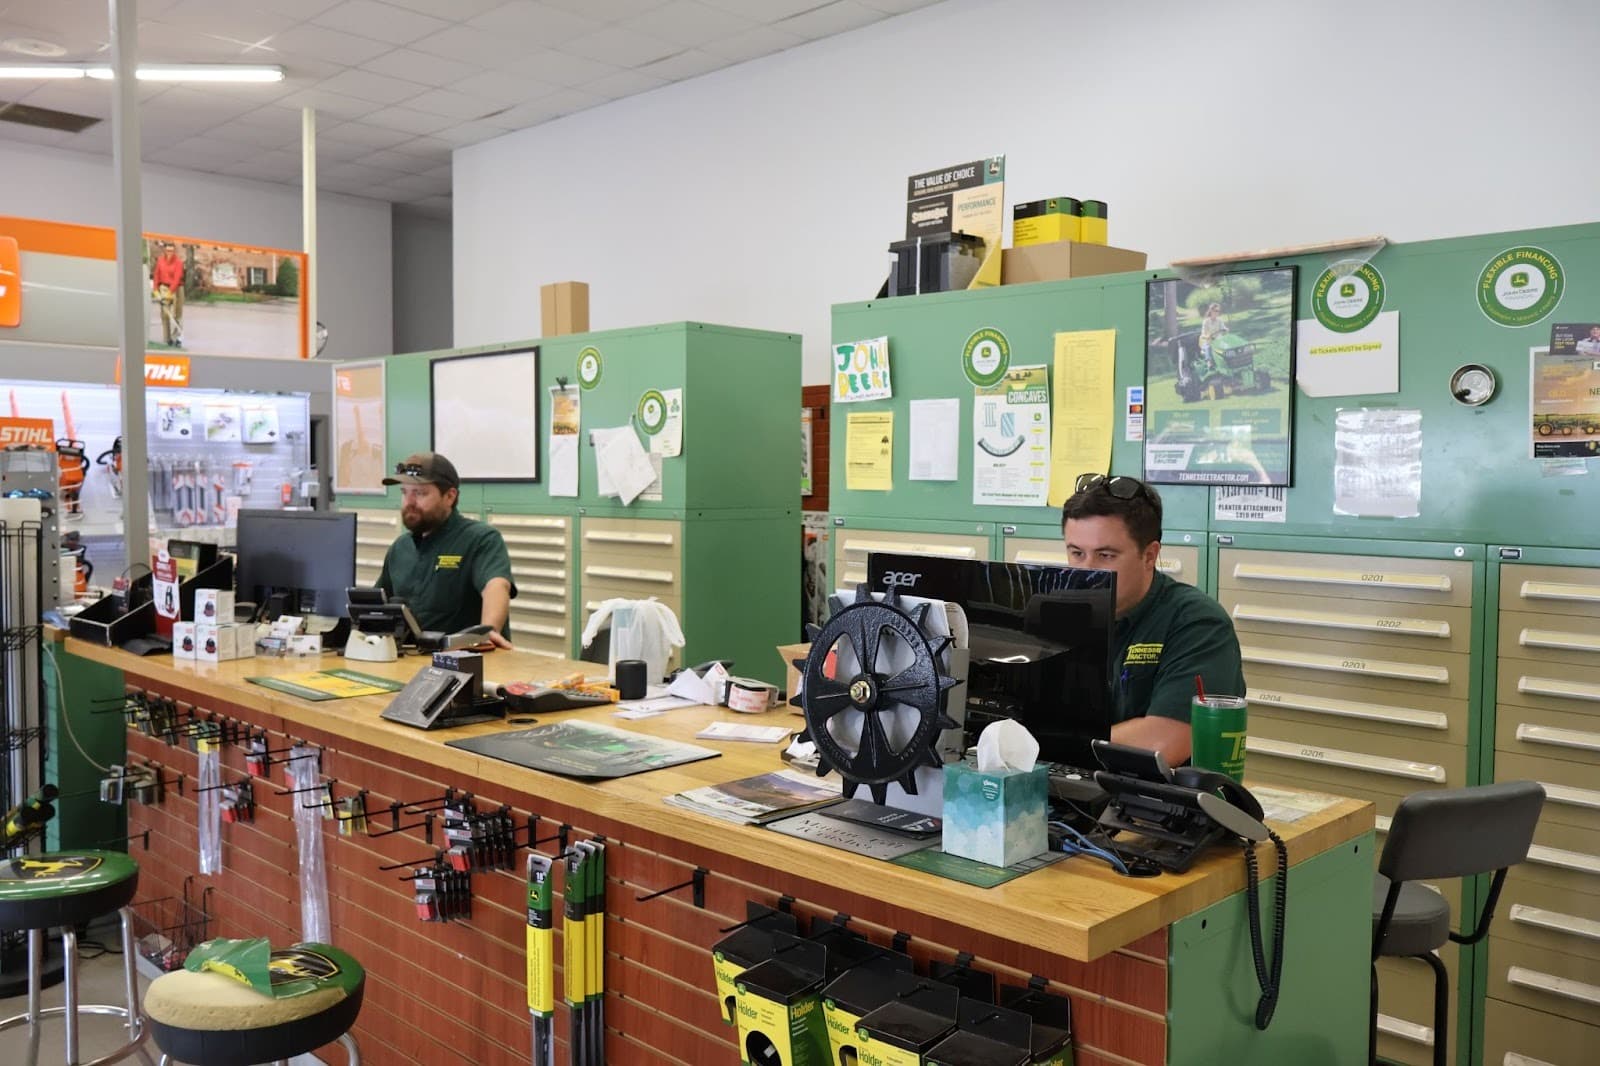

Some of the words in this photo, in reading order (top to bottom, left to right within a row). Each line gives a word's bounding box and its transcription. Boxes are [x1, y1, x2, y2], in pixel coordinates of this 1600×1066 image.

[914, 178, 927, 189] THE
[944, 171, 953, 182] OF
[953, 166, 976, 180] CHOICE
[1483, 254, 1514, 289] FLEXIBLE
[1516, 251, 1558, 280] FINANCING
[1318, 346, 1338, 355] Tickets
[1338, 345, 1354, 353] MUST
[1362, 342, 1382, 352] Signed
[836, 343, 887, 372] JOHN
[145, 363, 187, 380] TIHL
[838, 370, 888, 398] DEERE
[1007, 390, 1047, 404] CONCAVES
[0, 426, 52, 444] STIHL
[1242, 504, 1282, 513] ATTACHMENTS
[882, 570, 922, 587] acer
[1361, 573, 1384, 583] 0201
[1376, 619, 1402, 629] 0202
[1341, 660, 1366, 670] 0203
[1259, 693, 1281, 702] 0204
[738, 1002, 759, 1020] Holder
[791, 1000, 815, 1019] Holder
[827, 1015, 850, 1035] Holder
[859, 1048, 883, 1066] Holder
